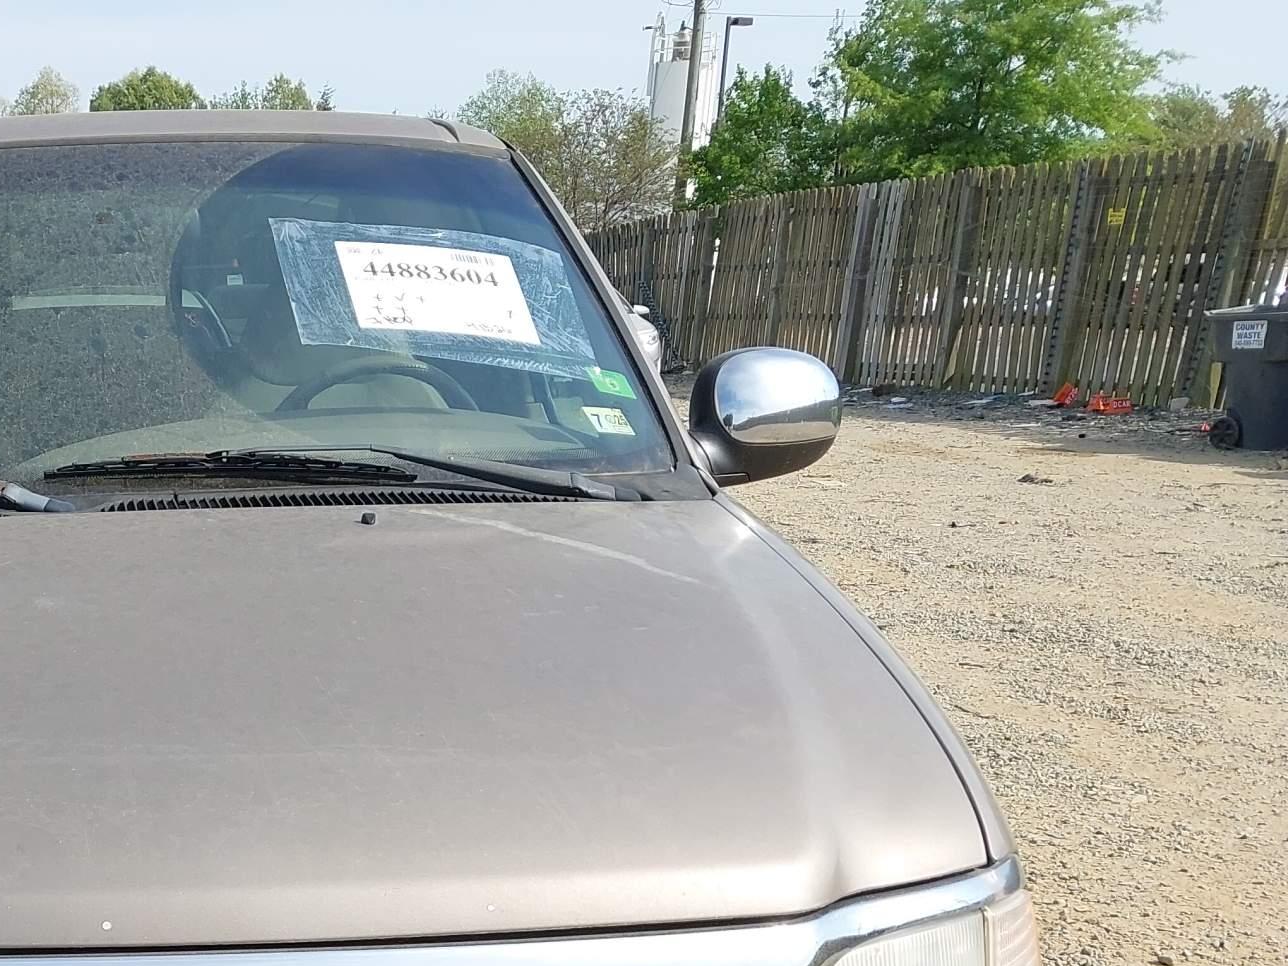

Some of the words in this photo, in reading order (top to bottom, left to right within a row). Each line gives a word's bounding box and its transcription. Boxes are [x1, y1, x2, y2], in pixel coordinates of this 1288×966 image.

[363, 261, 499, 287] 44883604
[1236, 322, 1265, 331] COUNTY
[1237, 331, 1264, 339] WASTE
